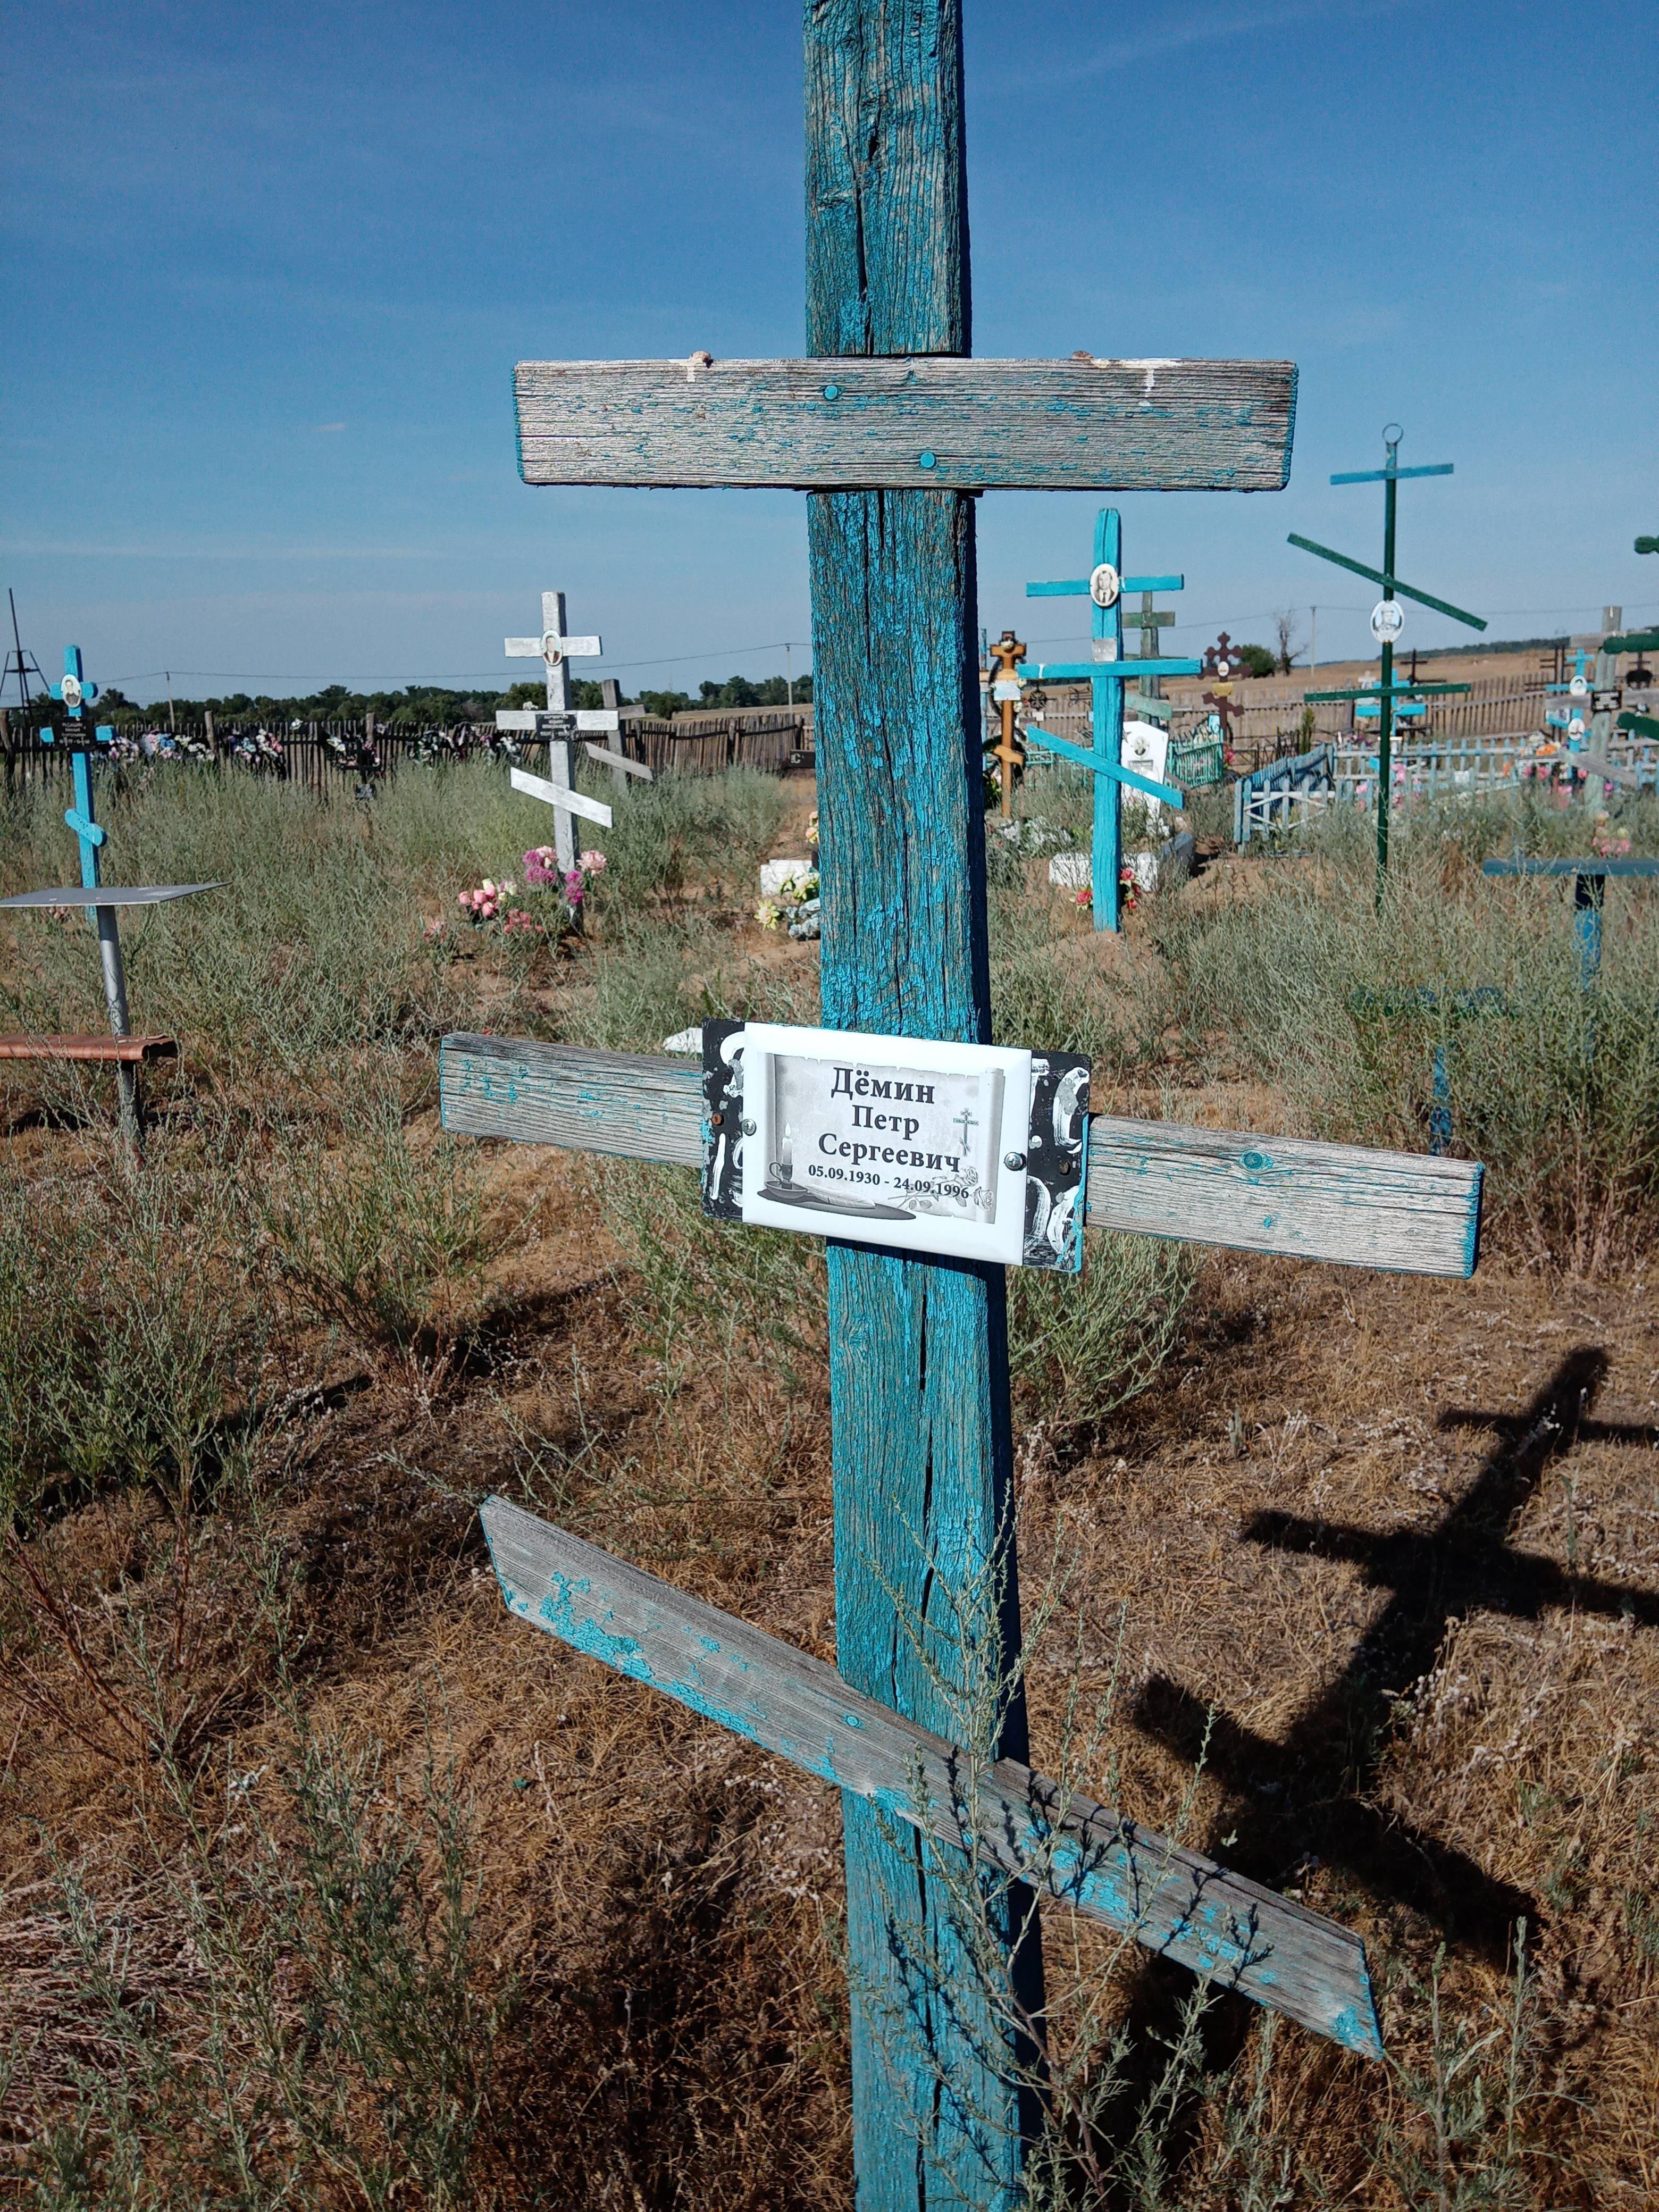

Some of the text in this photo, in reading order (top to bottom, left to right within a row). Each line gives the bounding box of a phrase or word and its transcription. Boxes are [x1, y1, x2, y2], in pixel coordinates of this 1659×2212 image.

[831, 1067, 935, 1104] Дёмин
[851, 1104, 919, 1141] Петр
[818, 1133, 960, 1173] Сергеевич
[808, 1164, 881, 1185] 05.09.1930
[893, 1177, 969, 1199] 24.09.1996
